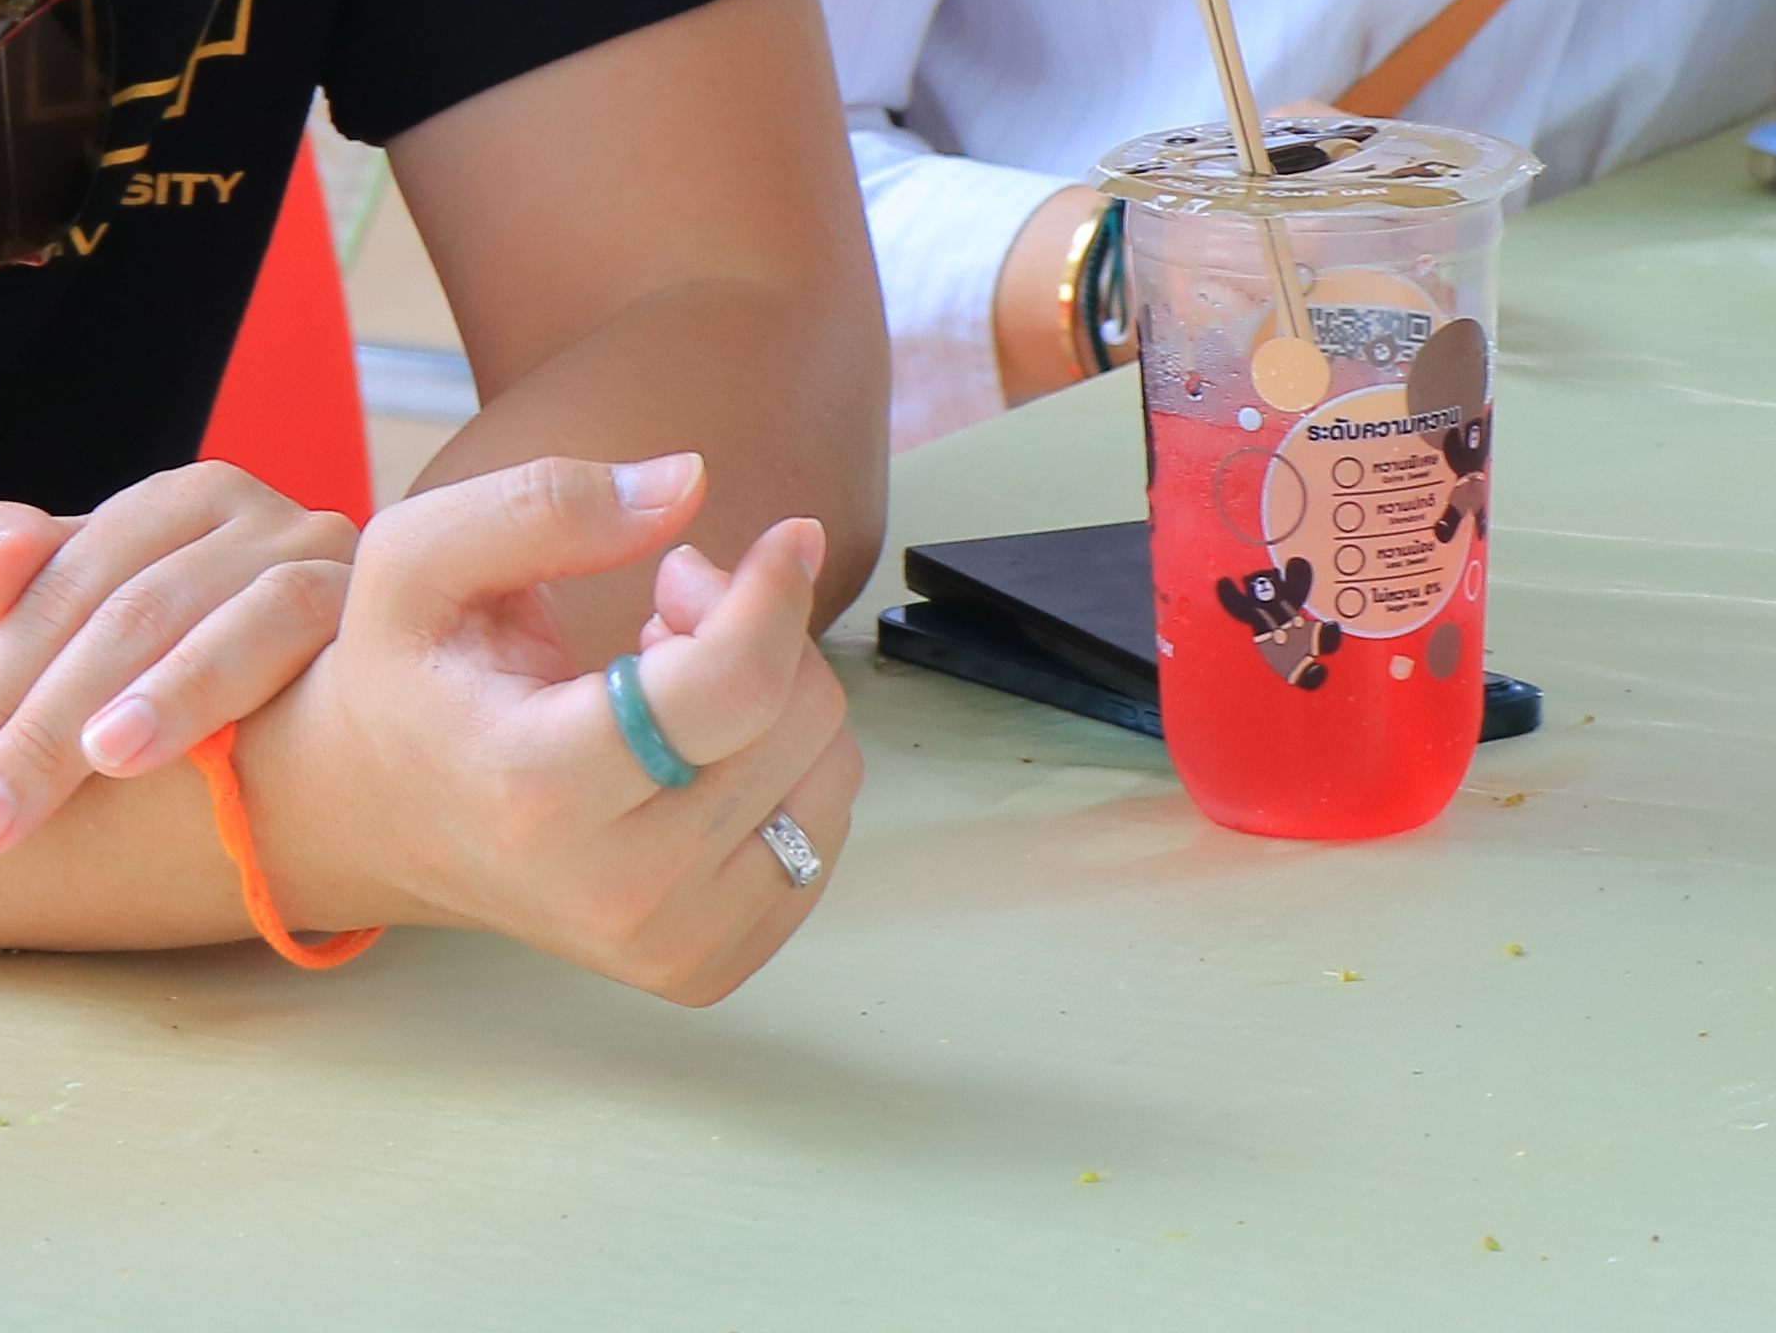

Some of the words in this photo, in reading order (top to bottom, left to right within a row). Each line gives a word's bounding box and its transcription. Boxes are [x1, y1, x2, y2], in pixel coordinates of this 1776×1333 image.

[1307, 405, 1462, 442] ระดับความหวาน
